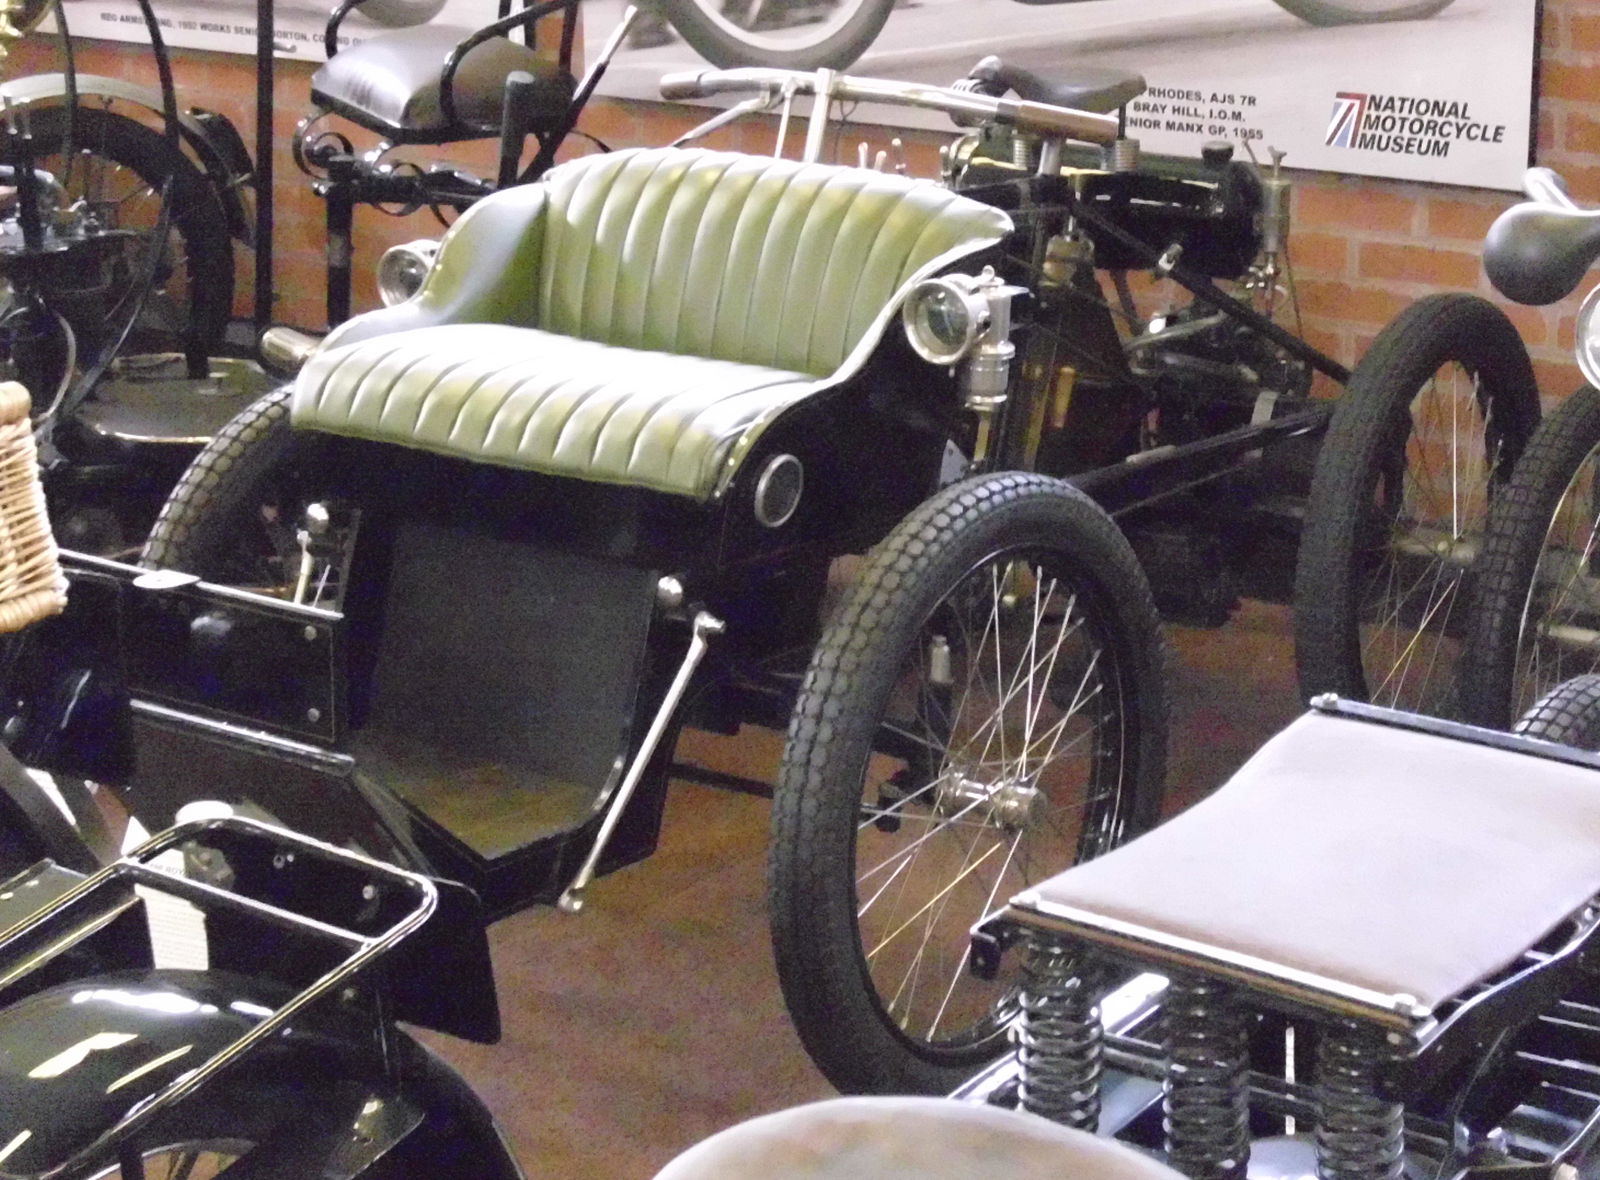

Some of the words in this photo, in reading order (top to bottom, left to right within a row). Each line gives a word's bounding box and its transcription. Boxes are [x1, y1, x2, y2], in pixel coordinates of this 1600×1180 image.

[200, 22, 231, 34] WORKS
[1148, 86, 1206, 104] RHODES,
[1210, 92, 1235, 106] AJS
[1240, 95, 1257, 106] 7R
[1133, 101, 1168, 114] BRAY
[1171, 105, 1205, 119] HILL,
[1209, 109, 1246, 122] I.O.M.
[1367, 94, 1471, 121] NATIONAL
[1165, 120, 1204, 134] MANX
[1208, 124, 1228, 139] GP,
[1233, 127, 1264, 140] 1955
[1362, 114, 1506, 143] MOTORCYCLE
[1357, 132, 1451, 158] MUSEUM
